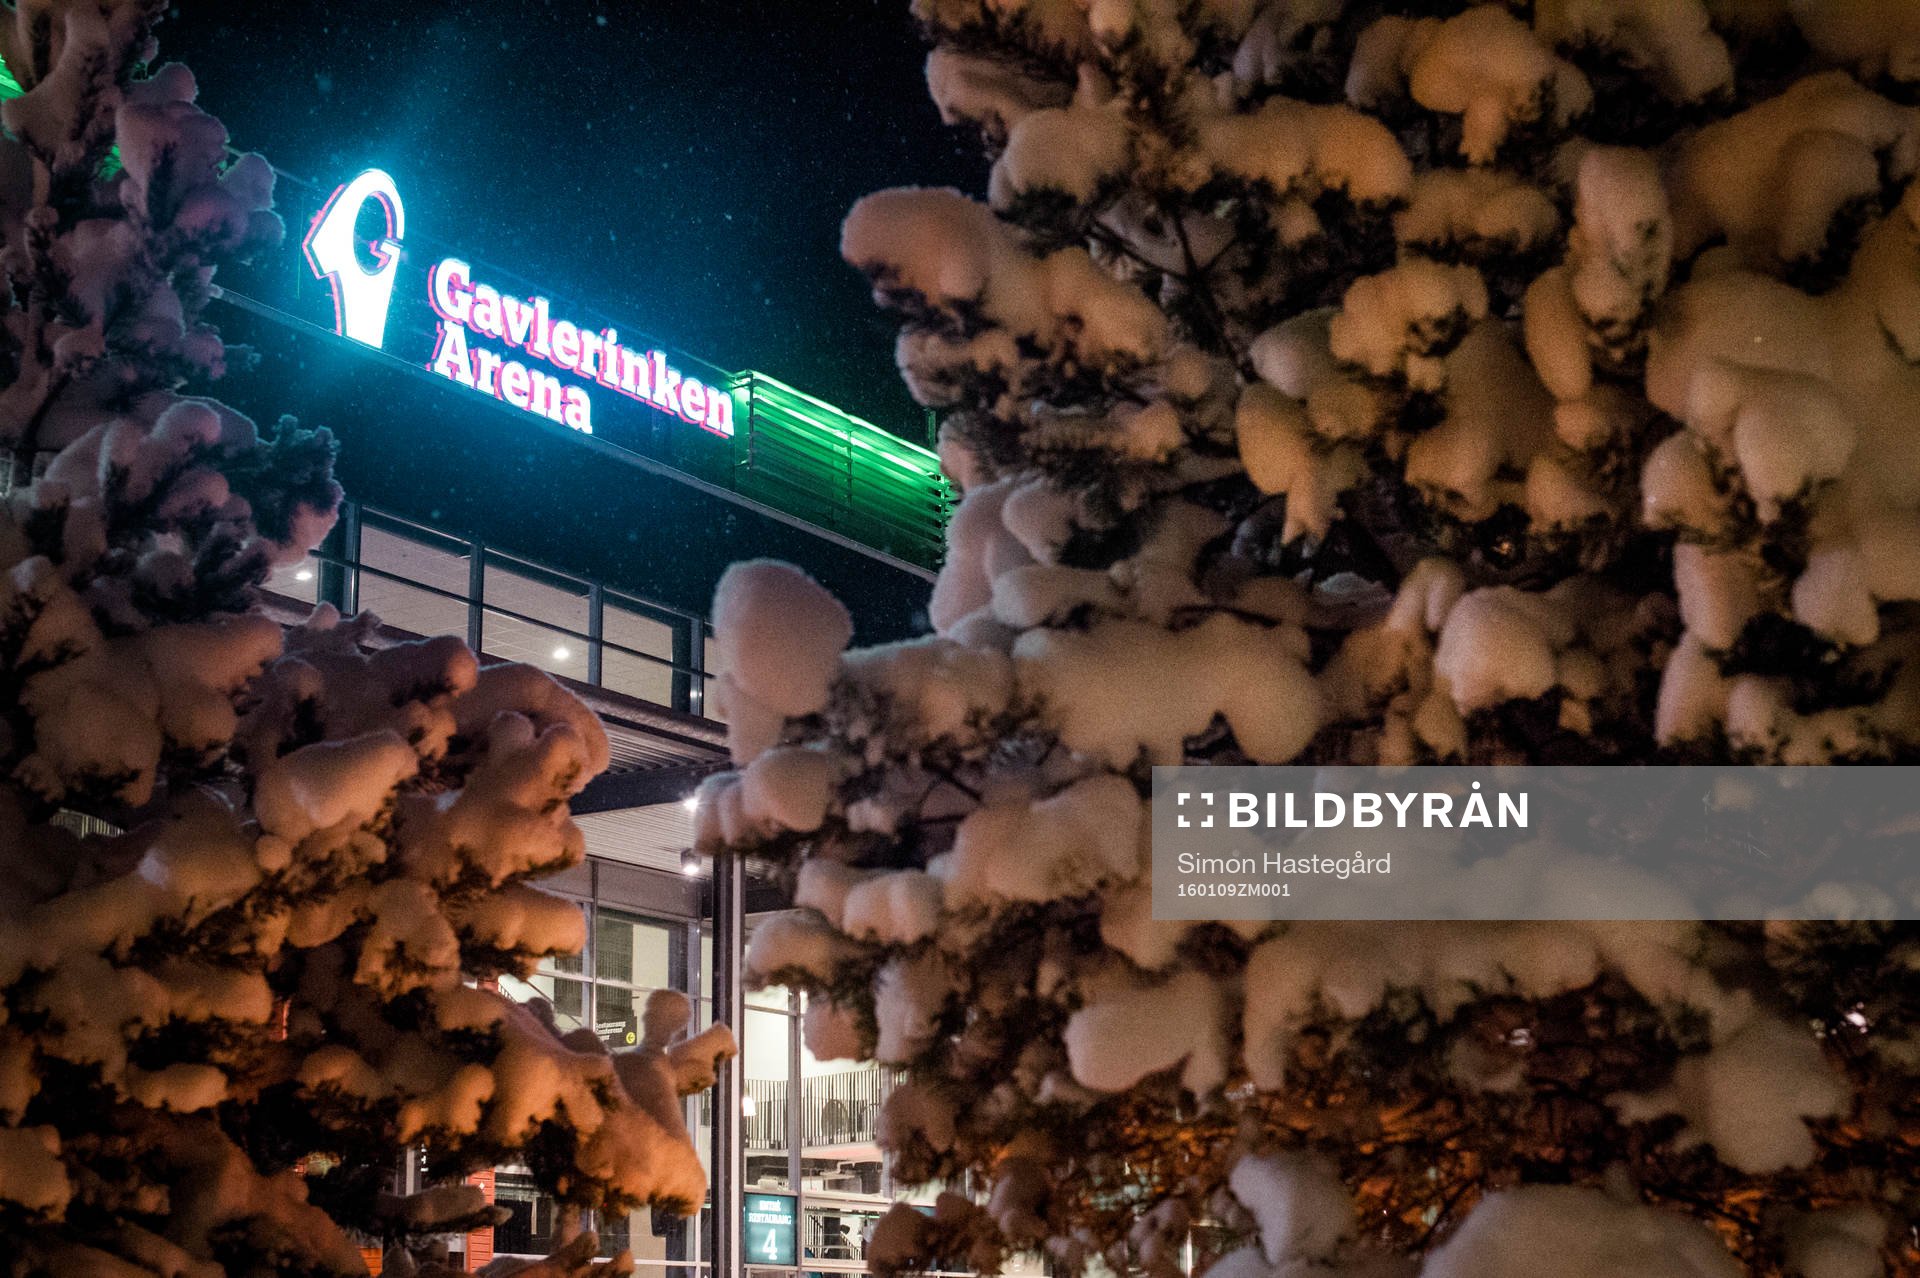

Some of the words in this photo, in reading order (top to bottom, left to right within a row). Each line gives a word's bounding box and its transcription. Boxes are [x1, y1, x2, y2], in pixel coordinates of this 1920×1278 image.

[426, 320, 593, 434] Arena
[429, 258, 735, 439] Gavlerinken
[763, 1228, 778, 1260] 4
